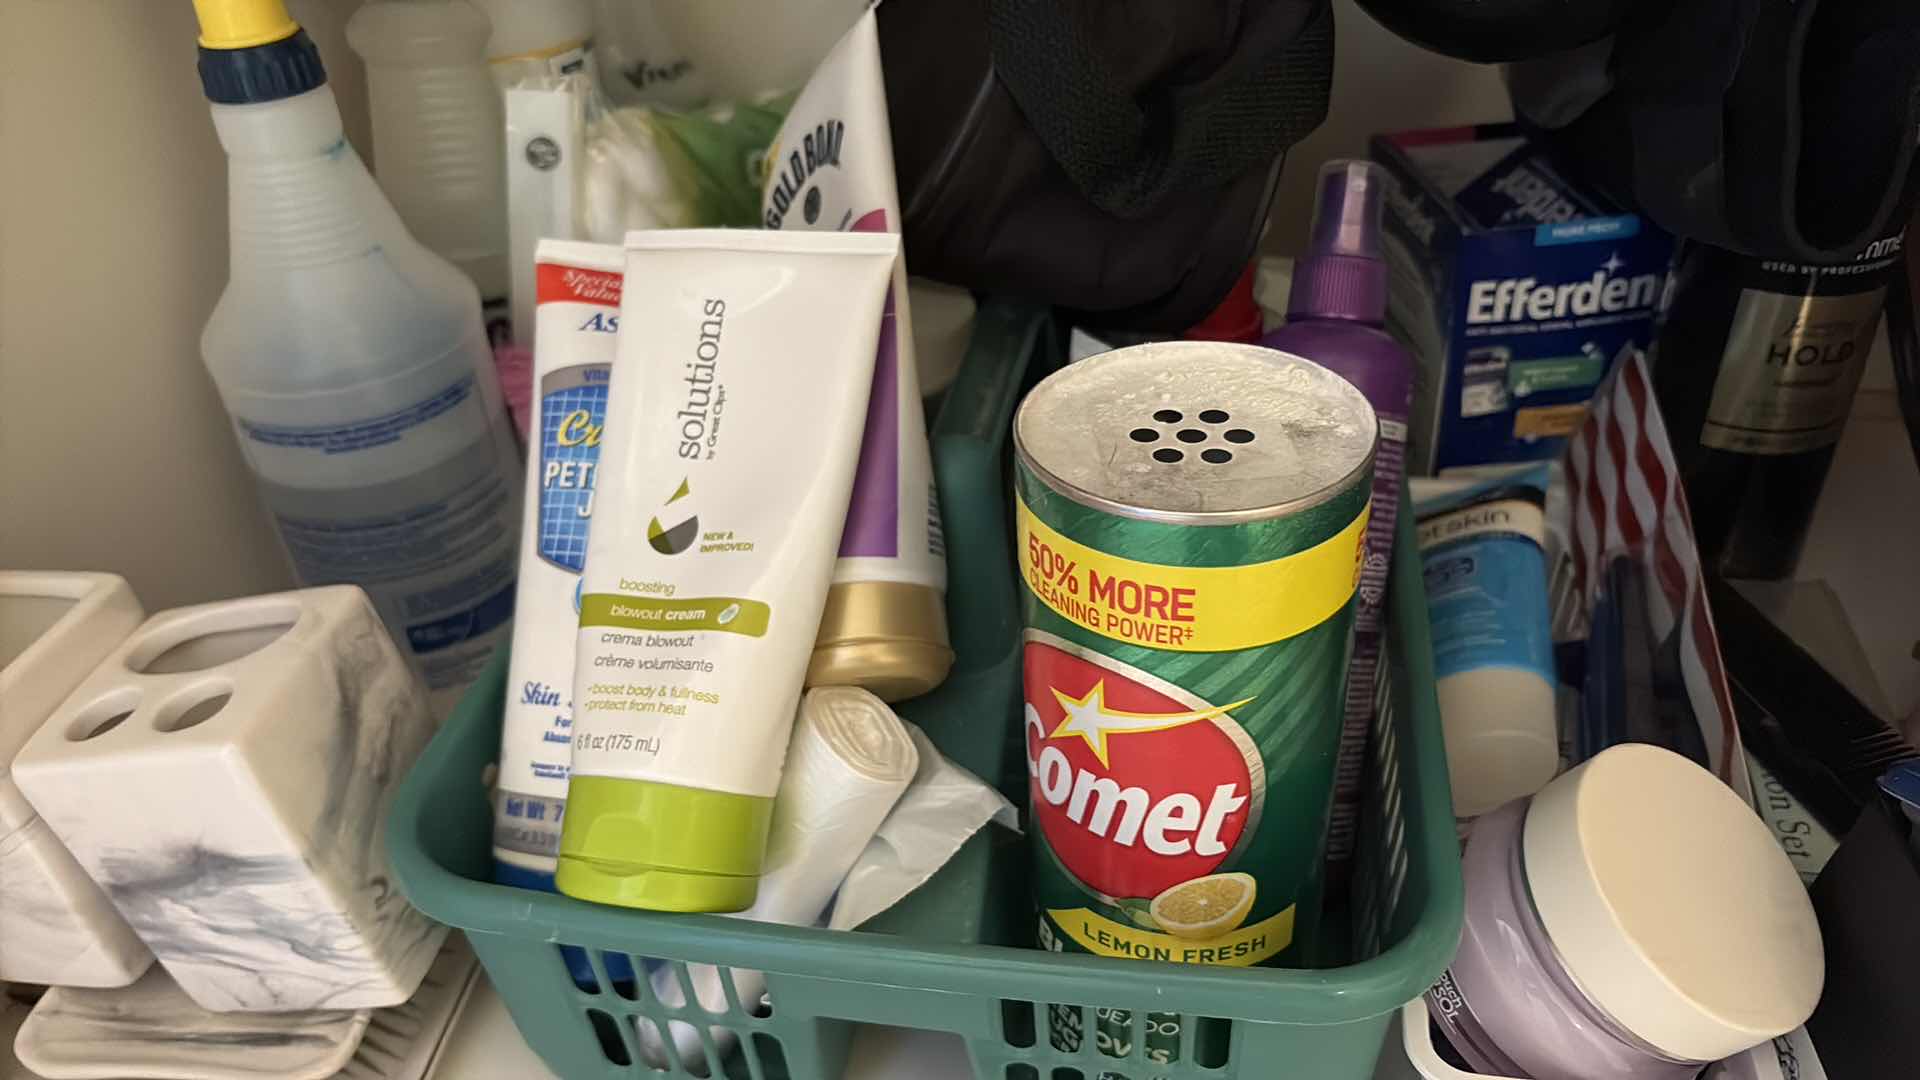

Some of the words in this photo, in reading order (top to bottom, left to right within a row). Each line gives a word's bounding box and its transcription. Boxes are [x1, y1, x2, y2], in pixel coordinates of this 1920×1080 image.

[766, 150, 806, 229] GOLD
[1467, 271, 1656, 324] Efferden
[577, 312, 619, 333] As
[1766, 341, 1856, 367] HOLD
[674, 298, 726, 460] solutions
[577, 491, 593, 519] J
[700, 543, 754, 553] IMPROVED!
[703, 532, 725, 541] NEW
[619, 578, 676, 596] boosting
[1028, 531, 1079, 596] 50%
[1088, 569, 1196, 623] MORE
[1030, 567, 1100, 627] CLEANING
[610, 604, 663, 619] blowout
[665, 608, 706, 621] cream
[600, 632, 642, 647] crema
[646, 634, 695, 648] blowout
[594, 653, 634, 668] crème
[638, 658, 714, 672] volumisante
[626, 684, 655, 699] body
[658, 686, 666, 697] &
[670, 687, 720, 704] fullness
[628, 699, 655, 712] from
[658, 701, 687, 715] heat
[635, 735, 661, 756] mL)
[1025, 702, 1248, 857] Comet
[1776, 819, 1812, 860] Set
[1083, 921, 1171, 962] LEMON
[1182, 934, 1267, 964] FRESH
[1440, 972, 1463, 1009] ouch
